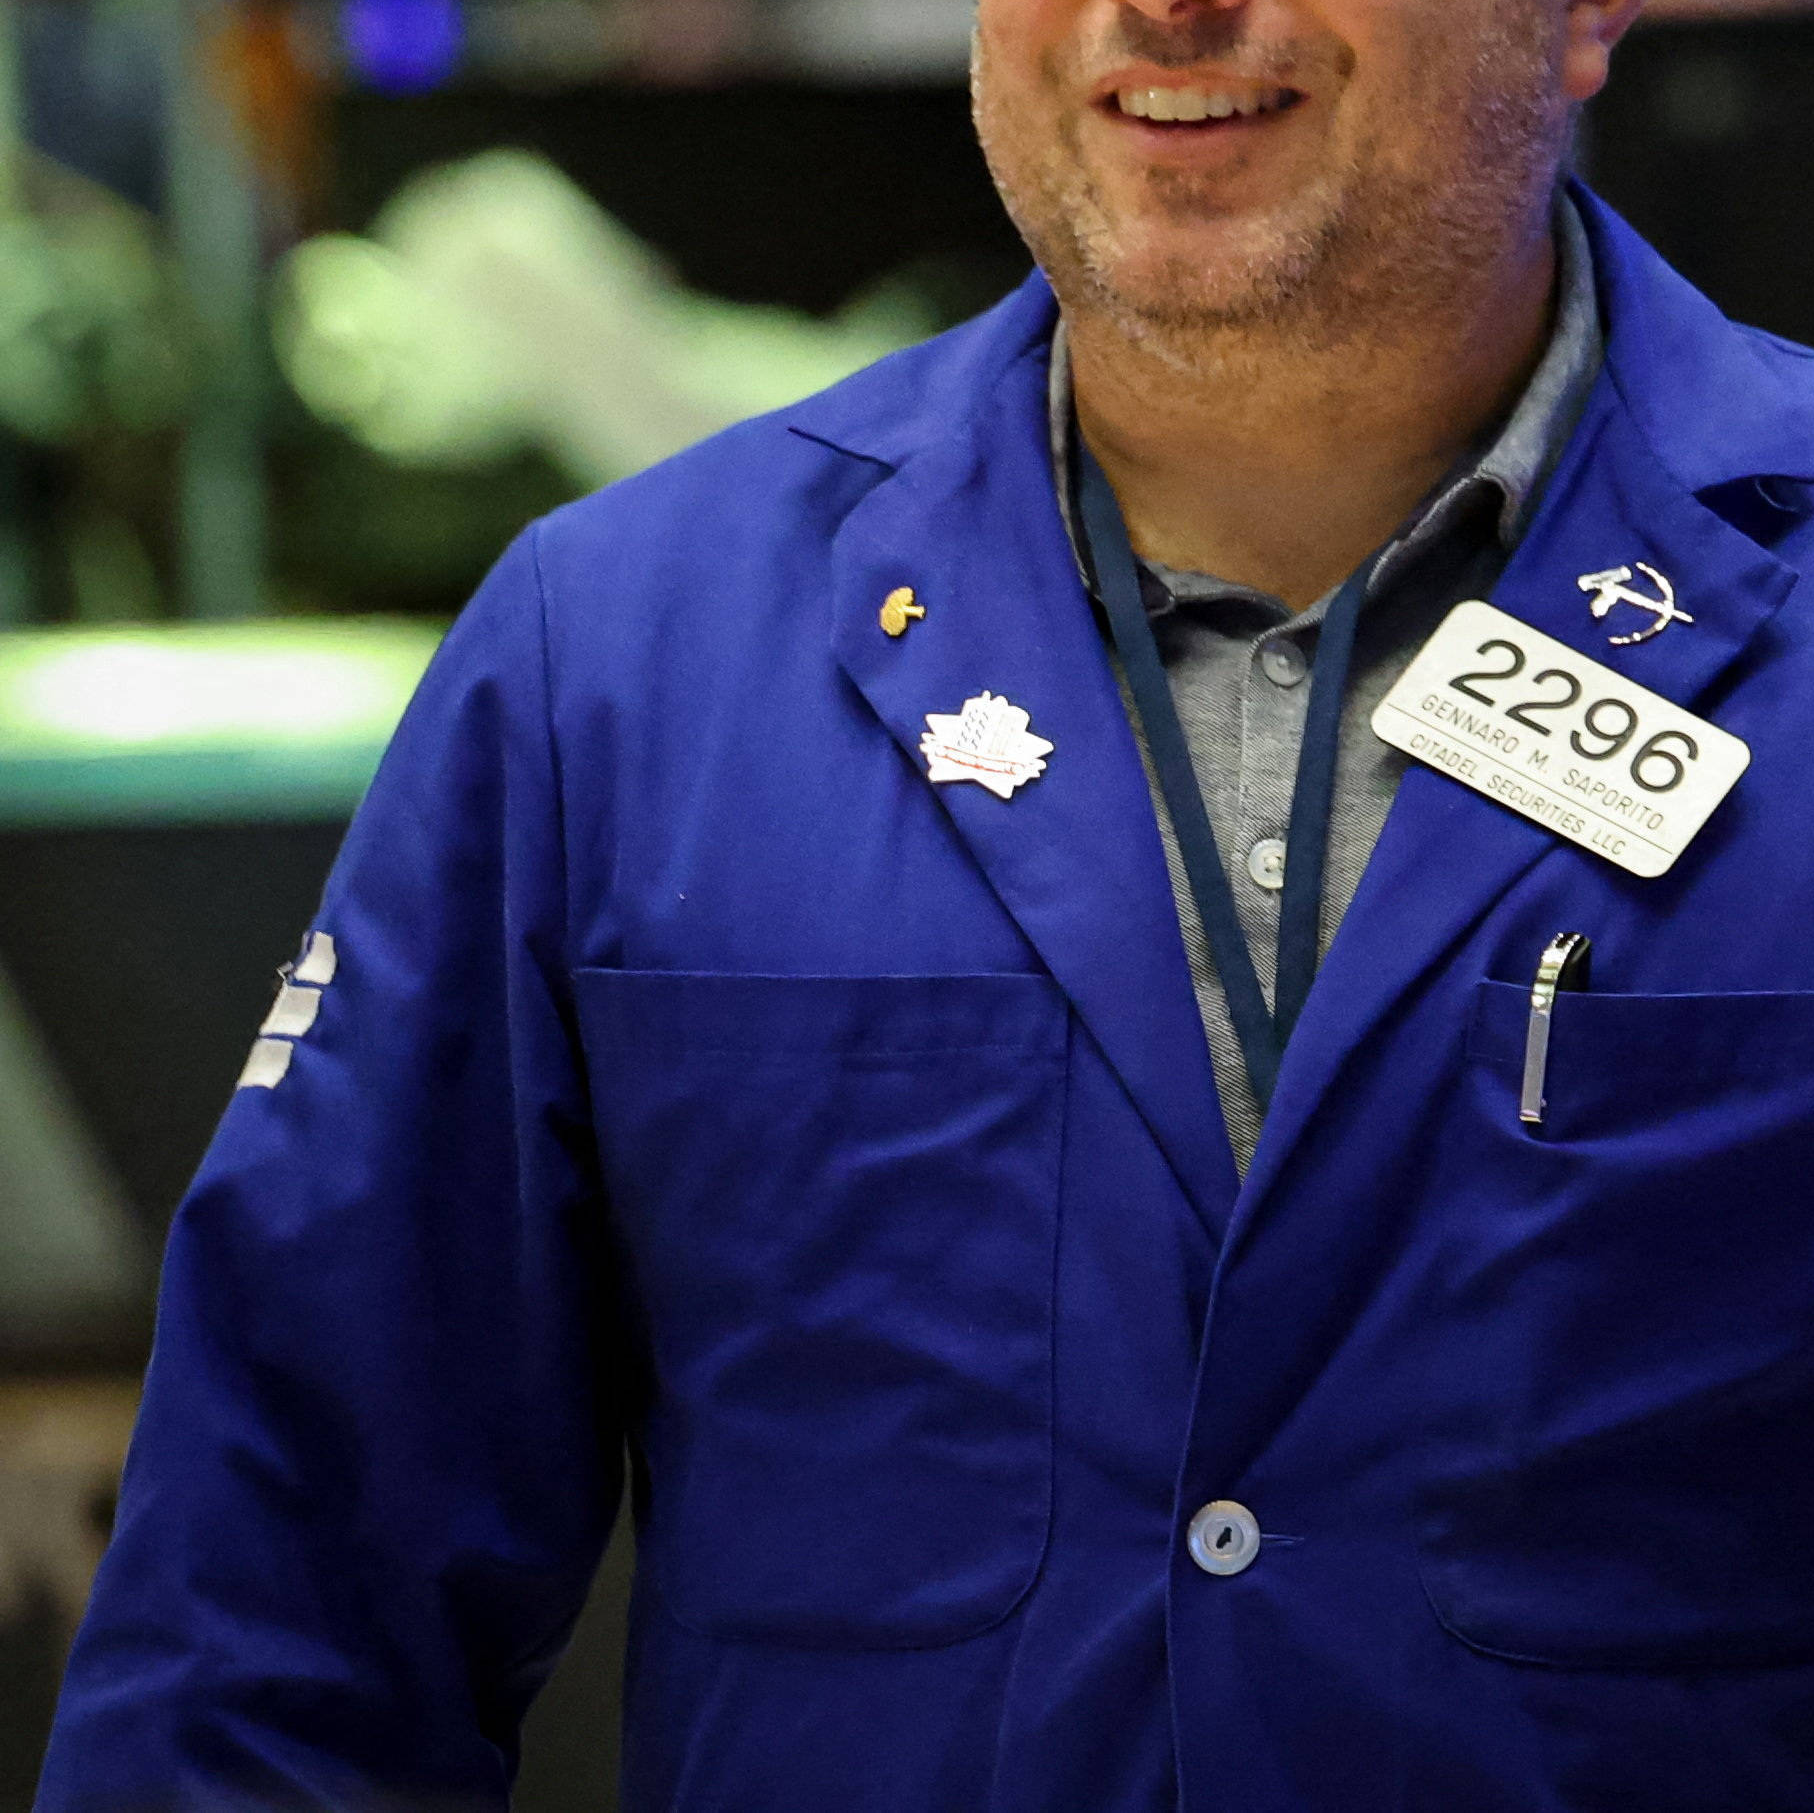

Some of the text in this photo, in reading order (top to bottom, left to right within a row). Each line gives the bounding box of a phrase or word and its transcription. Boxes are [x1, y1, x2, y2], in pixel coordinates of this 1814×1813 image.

[1421, 694, 1665, 831] GENNARO M. SAPORITO
[1448, 639, 1699, 793] 2296
[1409, 733, 1627, 856] CITADEL SECURITIES LLC
